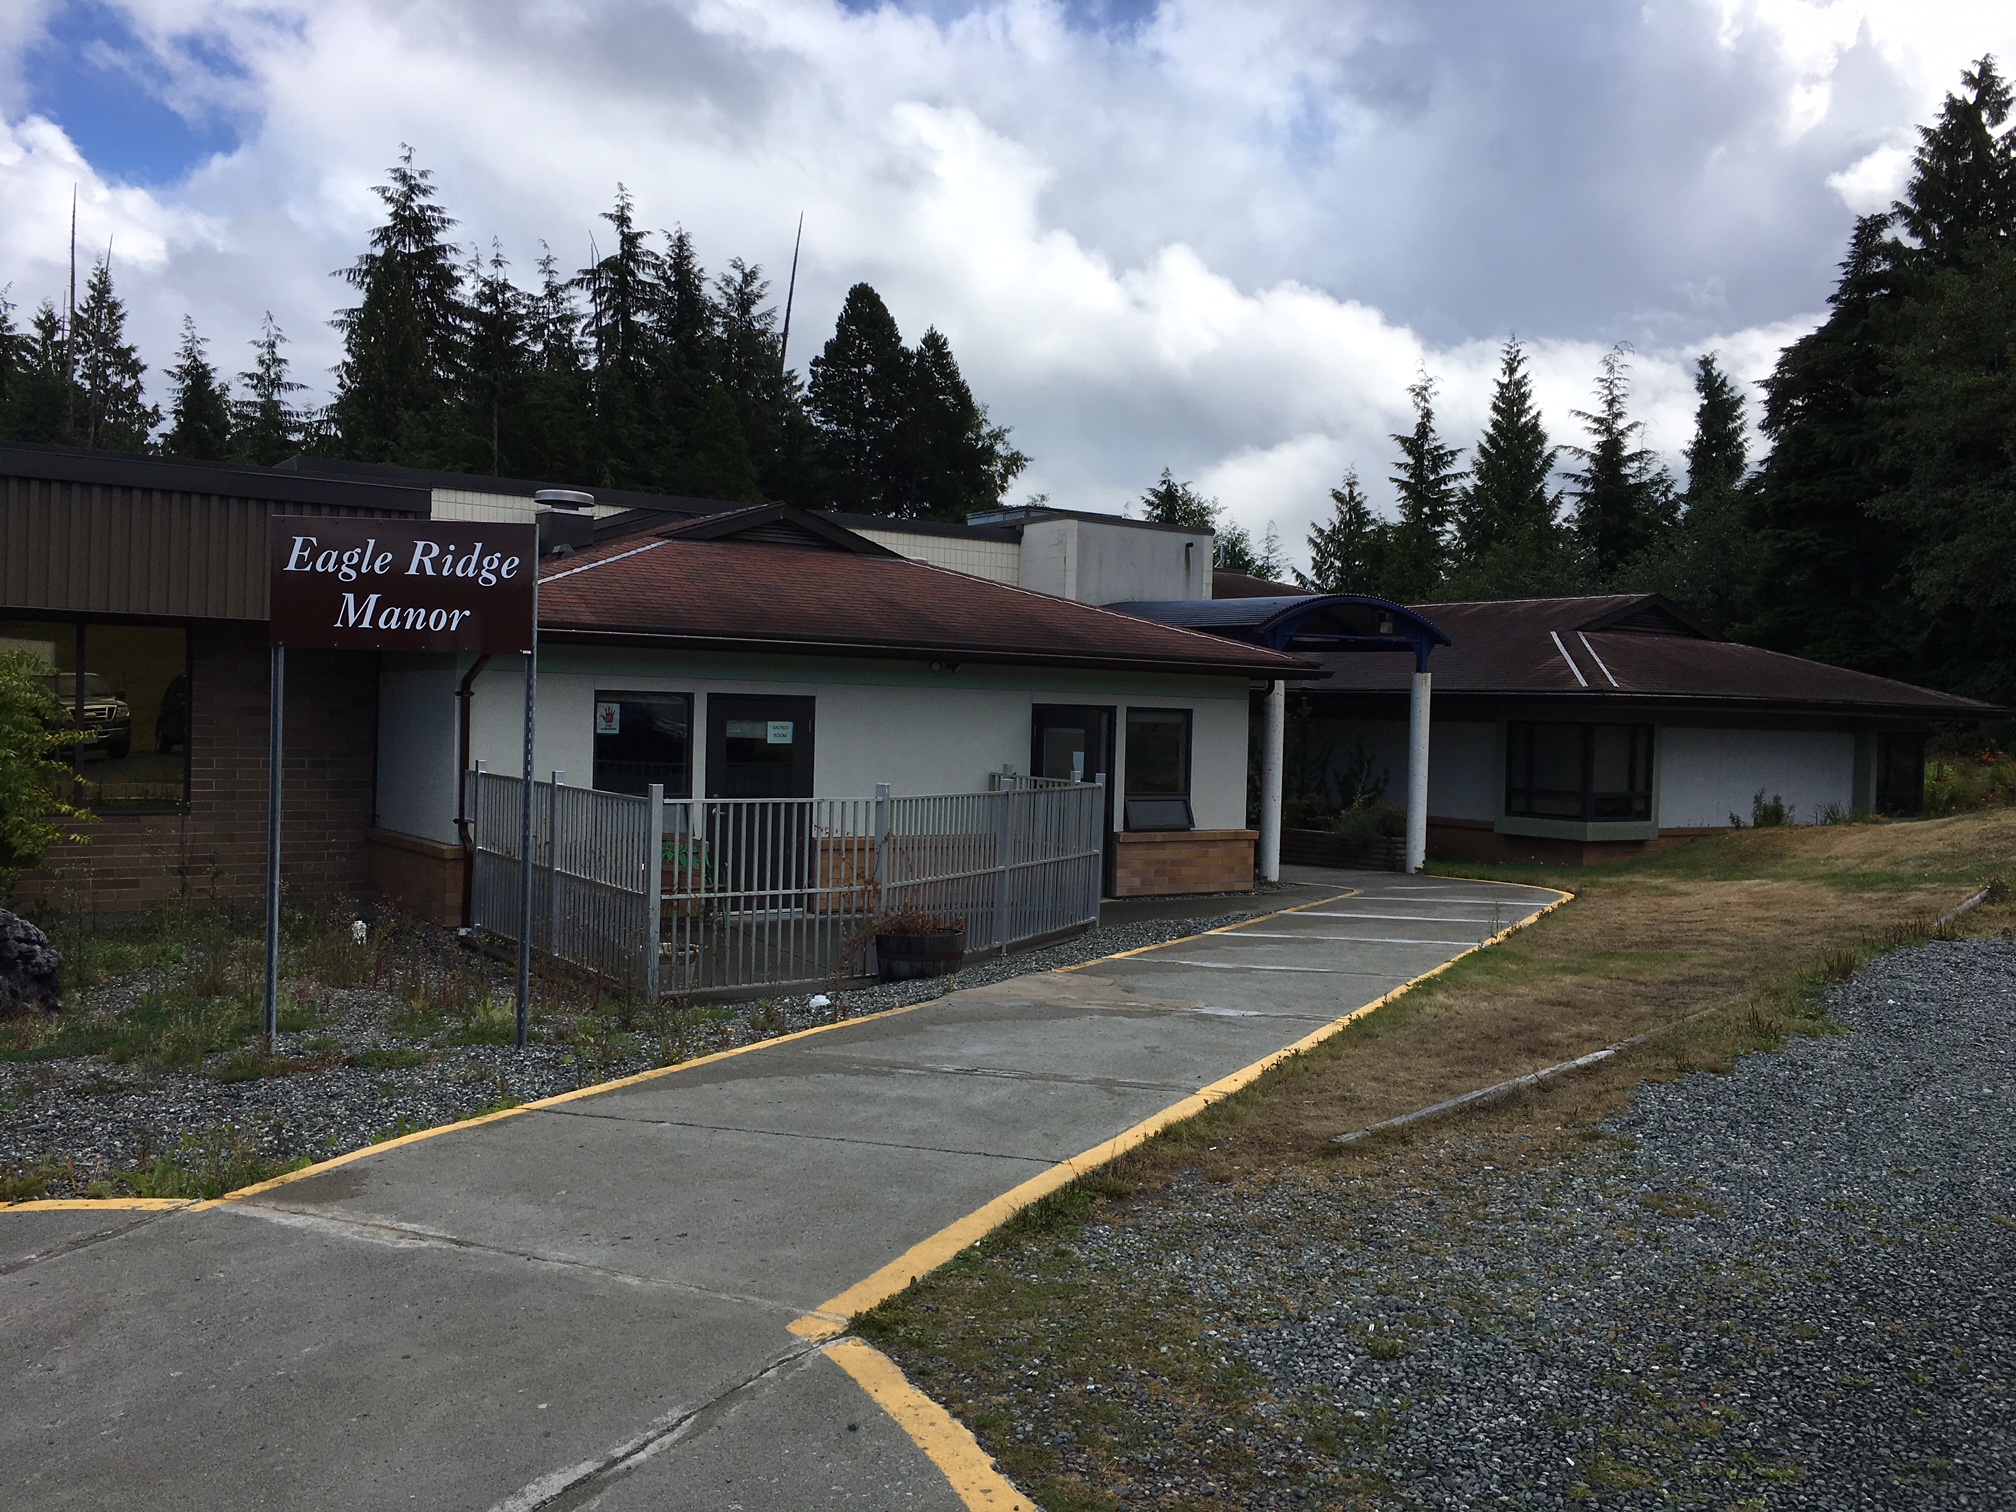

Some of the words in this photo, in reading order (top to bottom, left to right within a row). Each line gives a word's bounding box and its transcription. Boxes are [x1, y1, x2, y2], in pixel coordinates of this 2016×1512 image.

[282, 536, 394, 582] Eagle
[403, 540, 520, 587] Ridge
[333, 592, 471, 632] Manor
